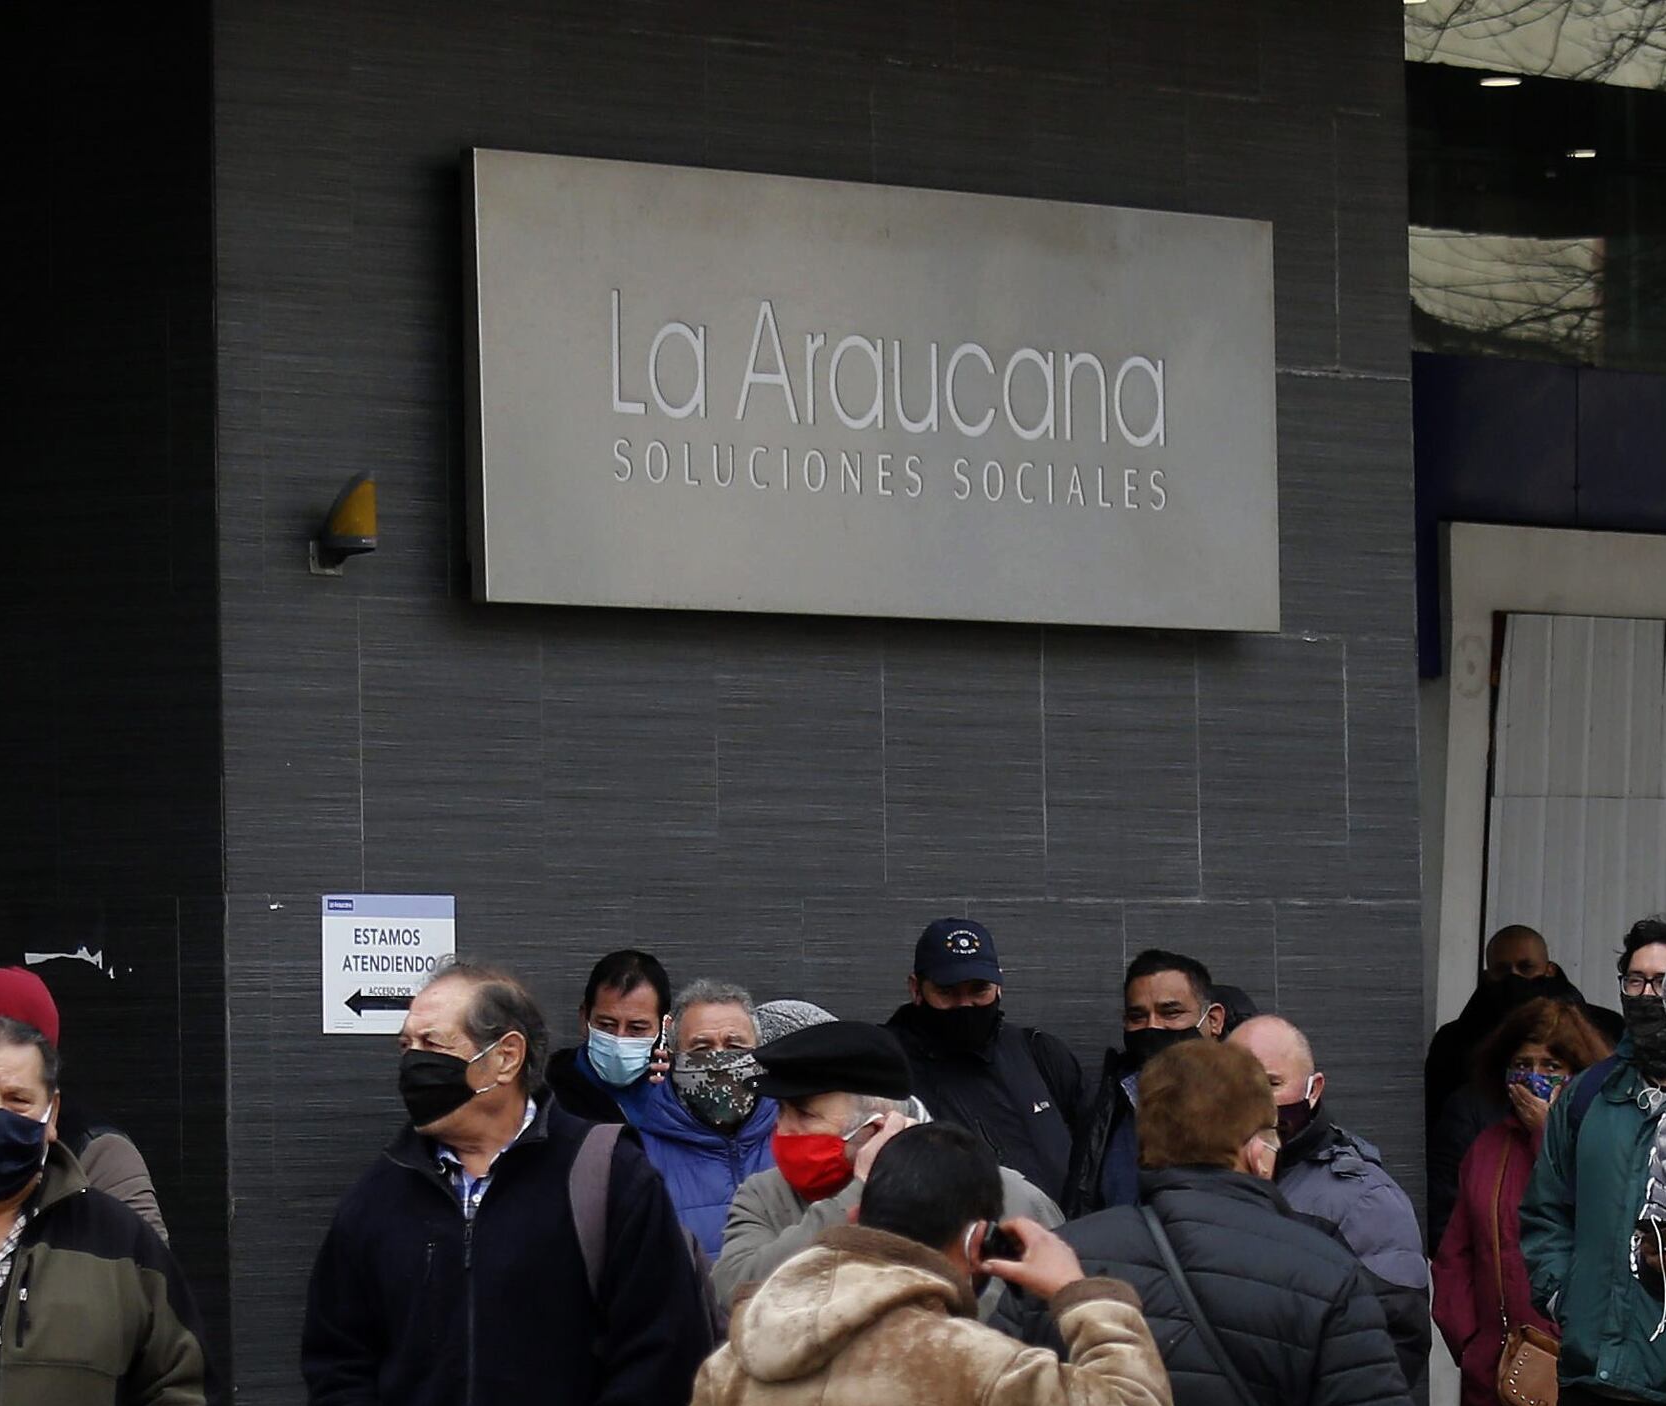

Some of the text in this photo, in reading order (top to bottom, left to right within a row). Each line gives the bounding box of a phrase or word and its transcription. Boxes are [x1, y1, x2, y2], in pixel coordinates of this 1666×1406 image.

[611, 287, 1168, 448] La Araucana
[613, 436, 1169, 511] SOLUCIONES SOCIALES
[353, 927, 421, 946] ESTAMOS
[342, 954, 436, 973] ATENDIENDO
[368, 986, 411, 996] ACCESO POR
